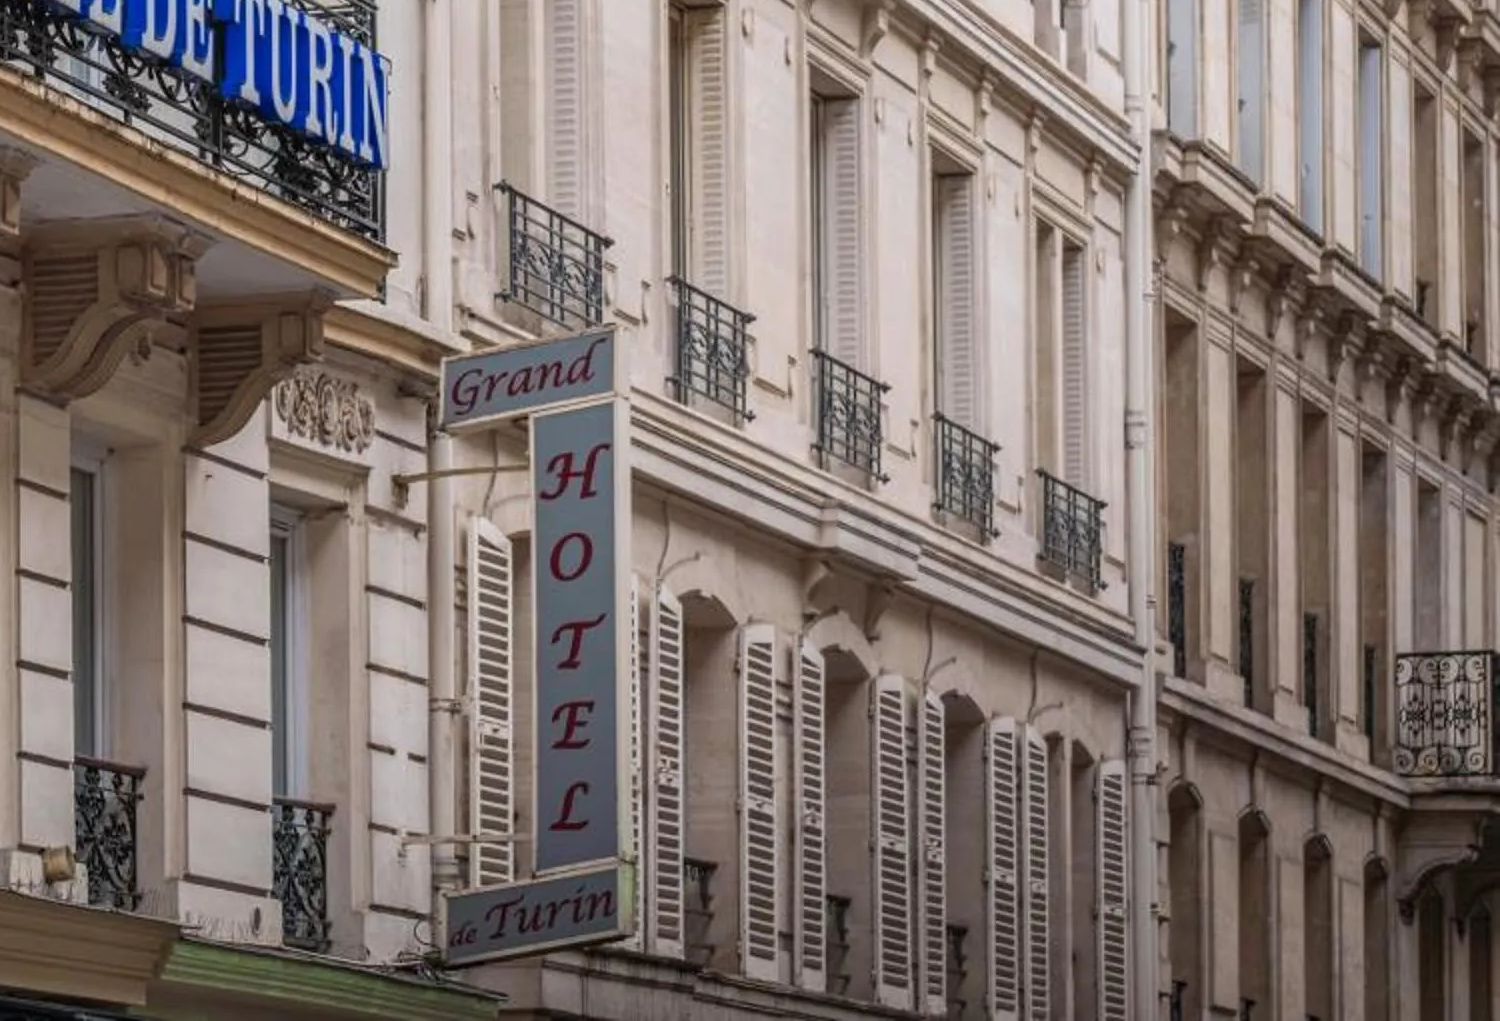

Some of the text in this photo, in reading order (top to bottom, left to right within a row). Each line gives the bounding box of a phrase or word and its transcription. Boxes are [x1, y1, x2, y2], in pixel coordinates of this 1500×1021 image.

[451, 337, 608, 416] Grand
[538, 442, 613, 834] HOTEL
[449, 883, 618, 948] de Turin
